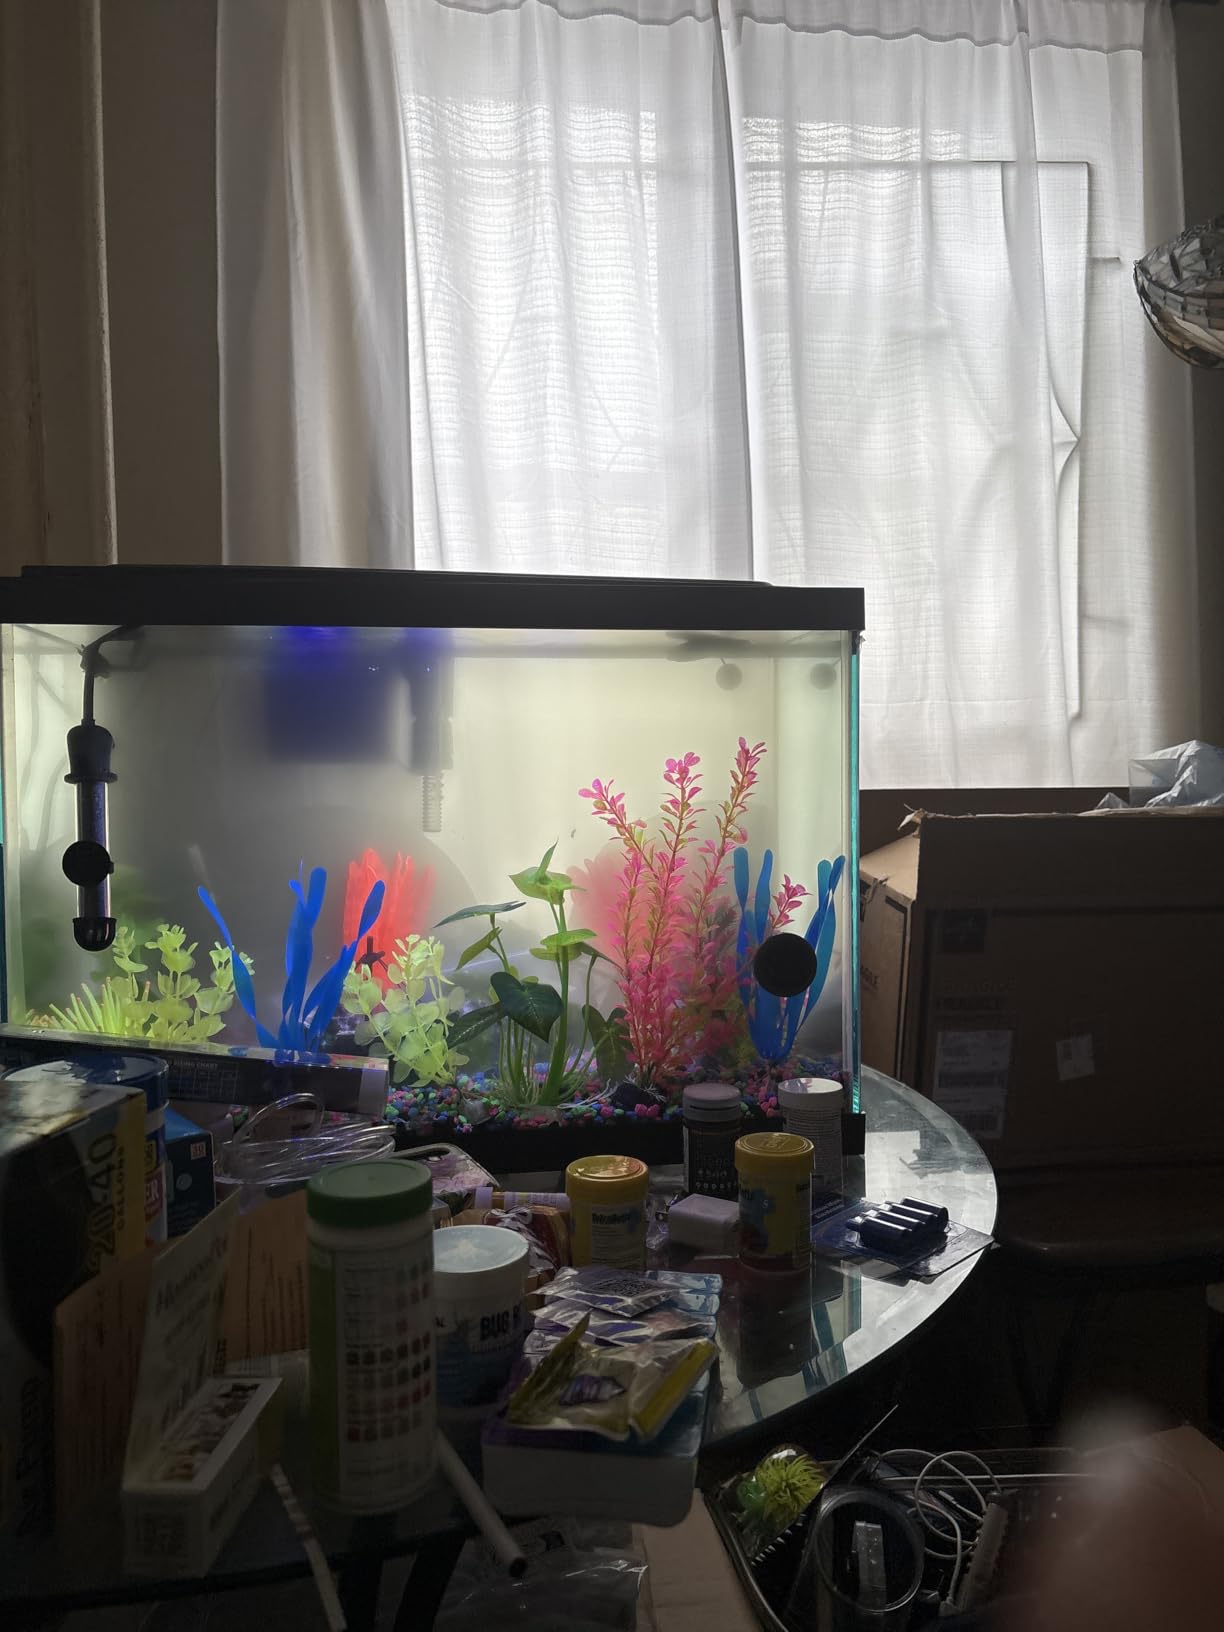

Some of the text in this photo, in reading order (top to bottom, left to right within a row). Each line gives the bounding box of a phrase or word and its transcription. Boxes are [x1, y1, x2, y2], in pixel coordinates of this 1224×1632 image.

[196, 1062, 219, 1070] CHART
[115, 1145, 124, 1231] GALLONS
[480, 1309, 510, 1341] BUG
